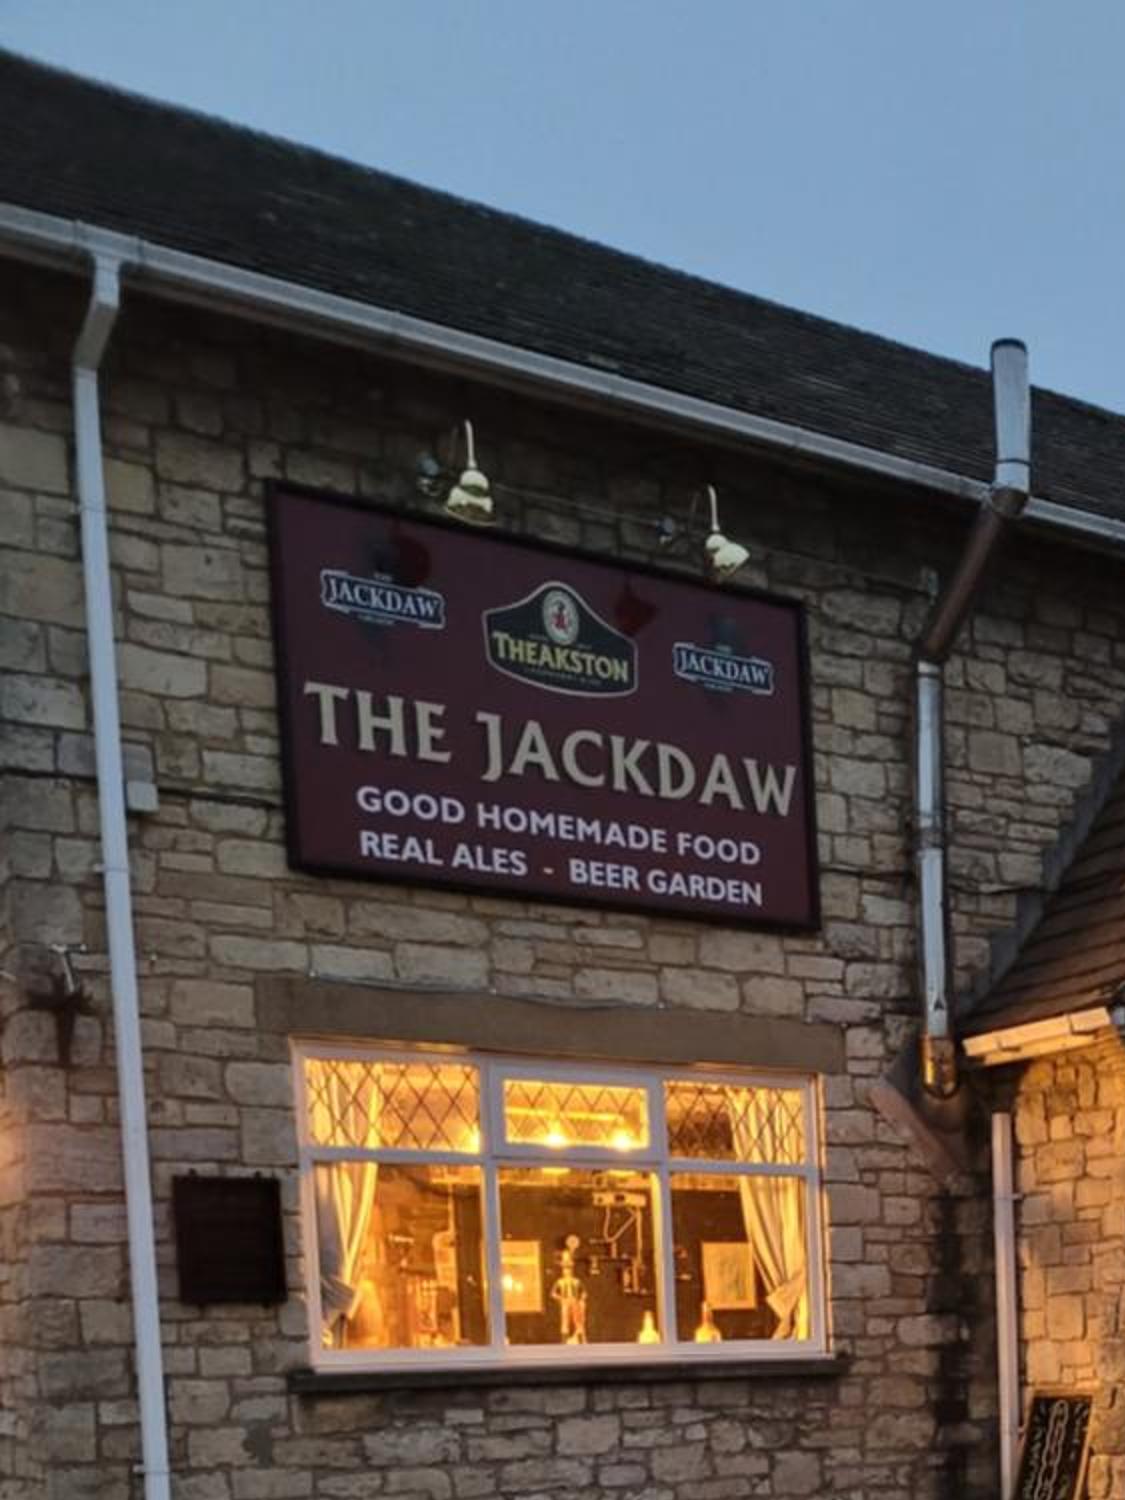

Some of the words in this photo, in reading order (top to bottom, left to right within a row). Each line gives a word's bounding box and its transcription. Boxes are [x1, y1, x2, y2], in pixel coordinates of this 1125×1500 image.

[328, 577, 440, 618] JACKDAW
[491, 629, 629, 683] THEAKSTON
[679, 649, 769, 686] JACKDAW
[303, 680, 452, 763] THE
[476, 710, 796, 817] JACKDAW
[356, 785, 465, 824] GOOD
[477, 802, 668, 854] HOMEMADE
[677, 831, 761, 866] FOOD
[359, 829, 444, 866] REAL
[451, 842, 529, 877] ALES
[568, 857, 641, 892] BEER
[647, 868, 764, 907] GARDEN
